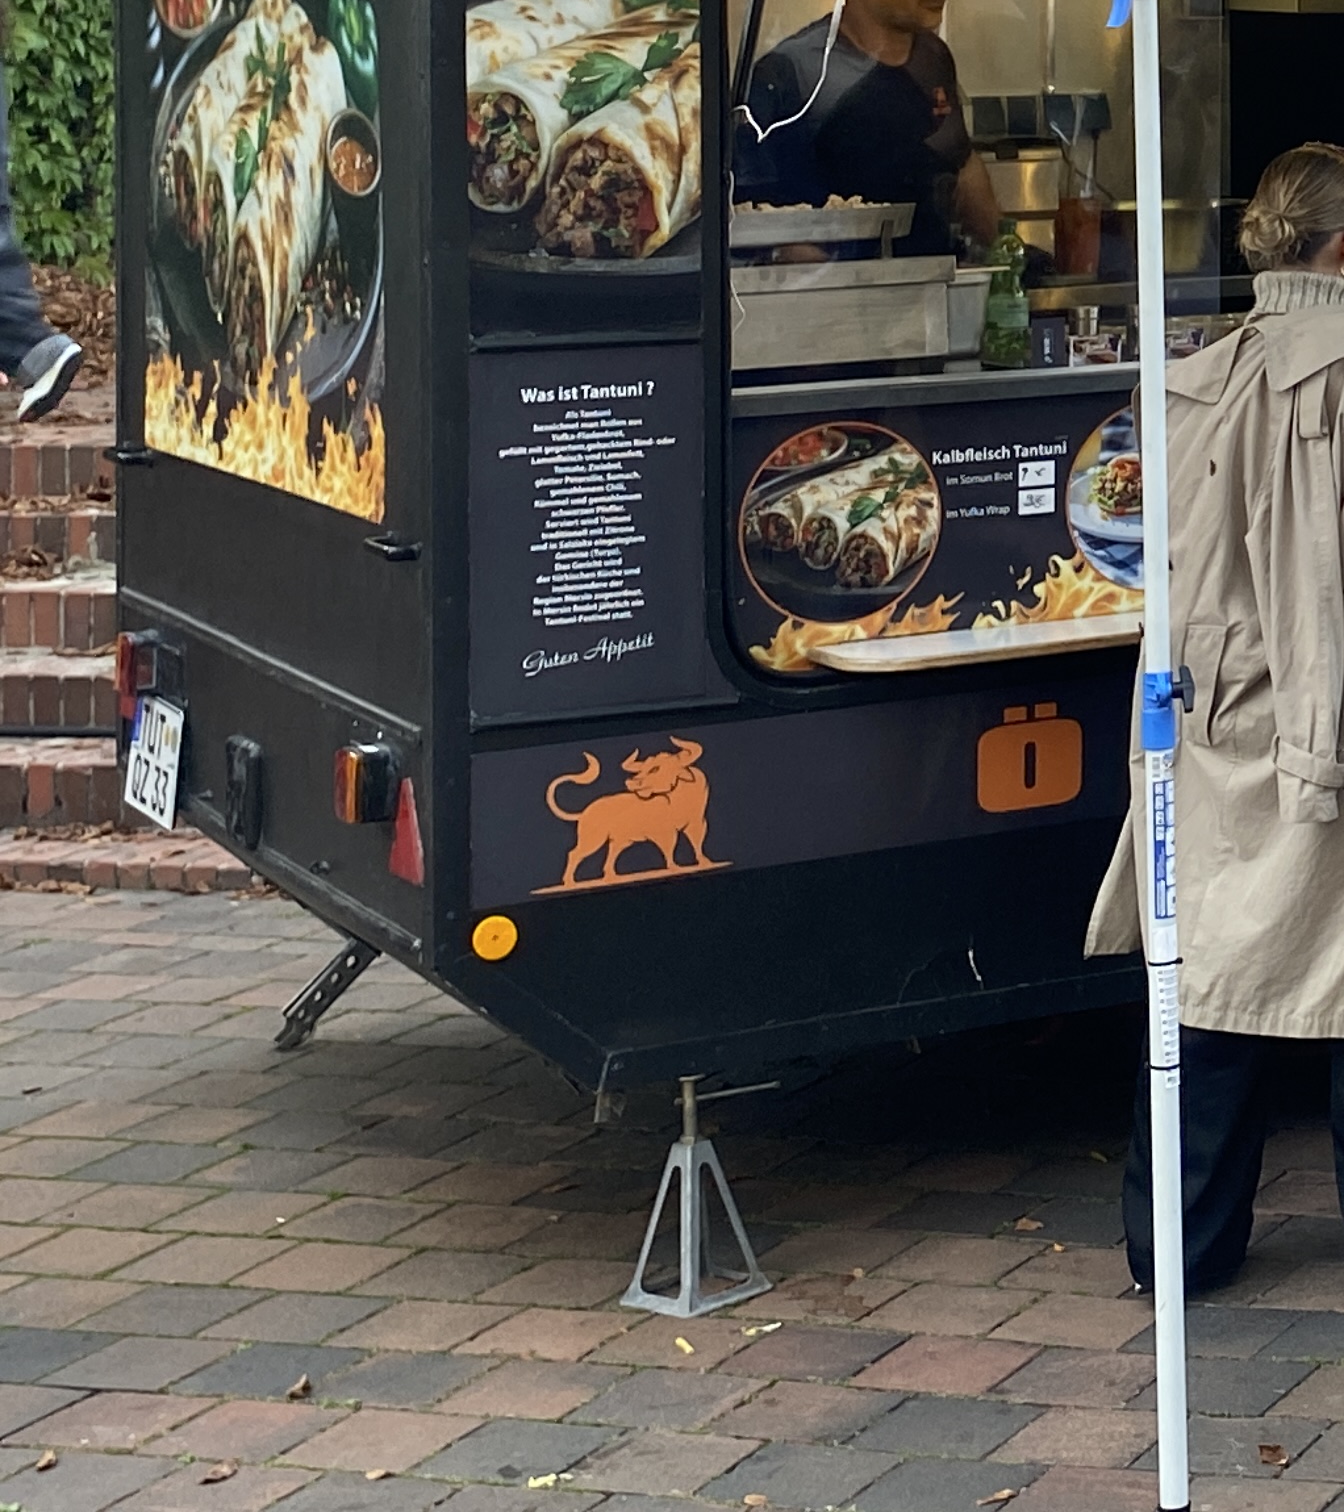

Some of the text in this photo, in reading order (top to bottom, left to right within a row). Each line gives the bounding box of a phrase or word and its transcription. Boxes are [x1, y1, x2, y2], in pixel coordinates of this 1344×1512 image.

[519, 387, 555, 404] Was
[557, 385, 578, 401] ist
[580, 380, 643, 400] Tantuni
[932, 440, 1068, 466] Kalbfleisch Tantuni
[522, 631, 655, 678] Guten Appetit
[150, 765, 169, 817] 33
